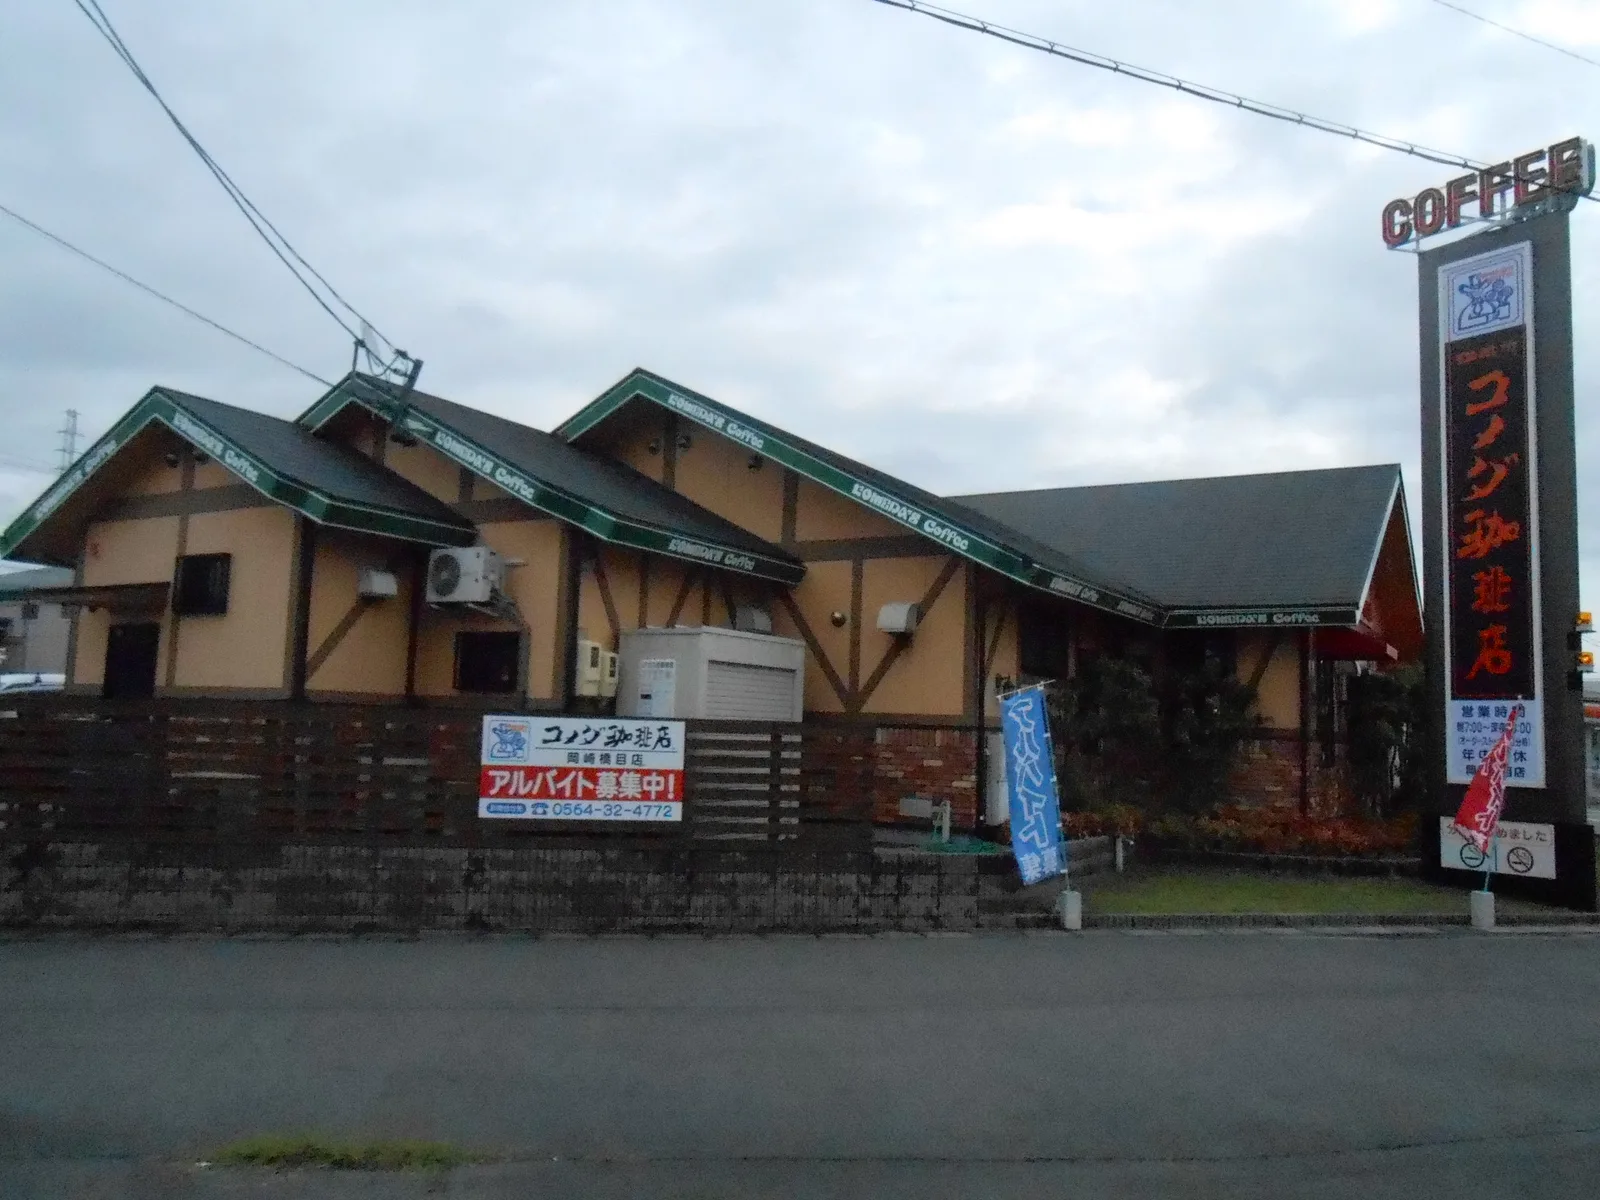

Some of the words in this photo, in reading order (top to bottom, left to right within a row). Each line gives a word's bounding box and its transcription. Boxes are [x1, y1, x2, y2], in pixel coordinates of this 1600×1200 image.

[1382, 137, 1585, 245] COFFEE
[726, 423, 764, 449] Coffee
[495, 467, 535, 499] Coffee
[924, 519, 968, 550] Coffee
[1457, 369, 1519, 679] コメダ珈琲店
[724, 553, 755, 571] Coffee
[1273, 613, 1320, 623] Coffee
[541, 725, 672, 750] コメダ珈琲店
[567, 752, 644, 767] 岡崎橋目店
[1462, 749, 1526, 762] 年中休
[488, 770, 675, 800] アルバイト募集中!
[553, 803, 673, 817] 0564-32-4772
